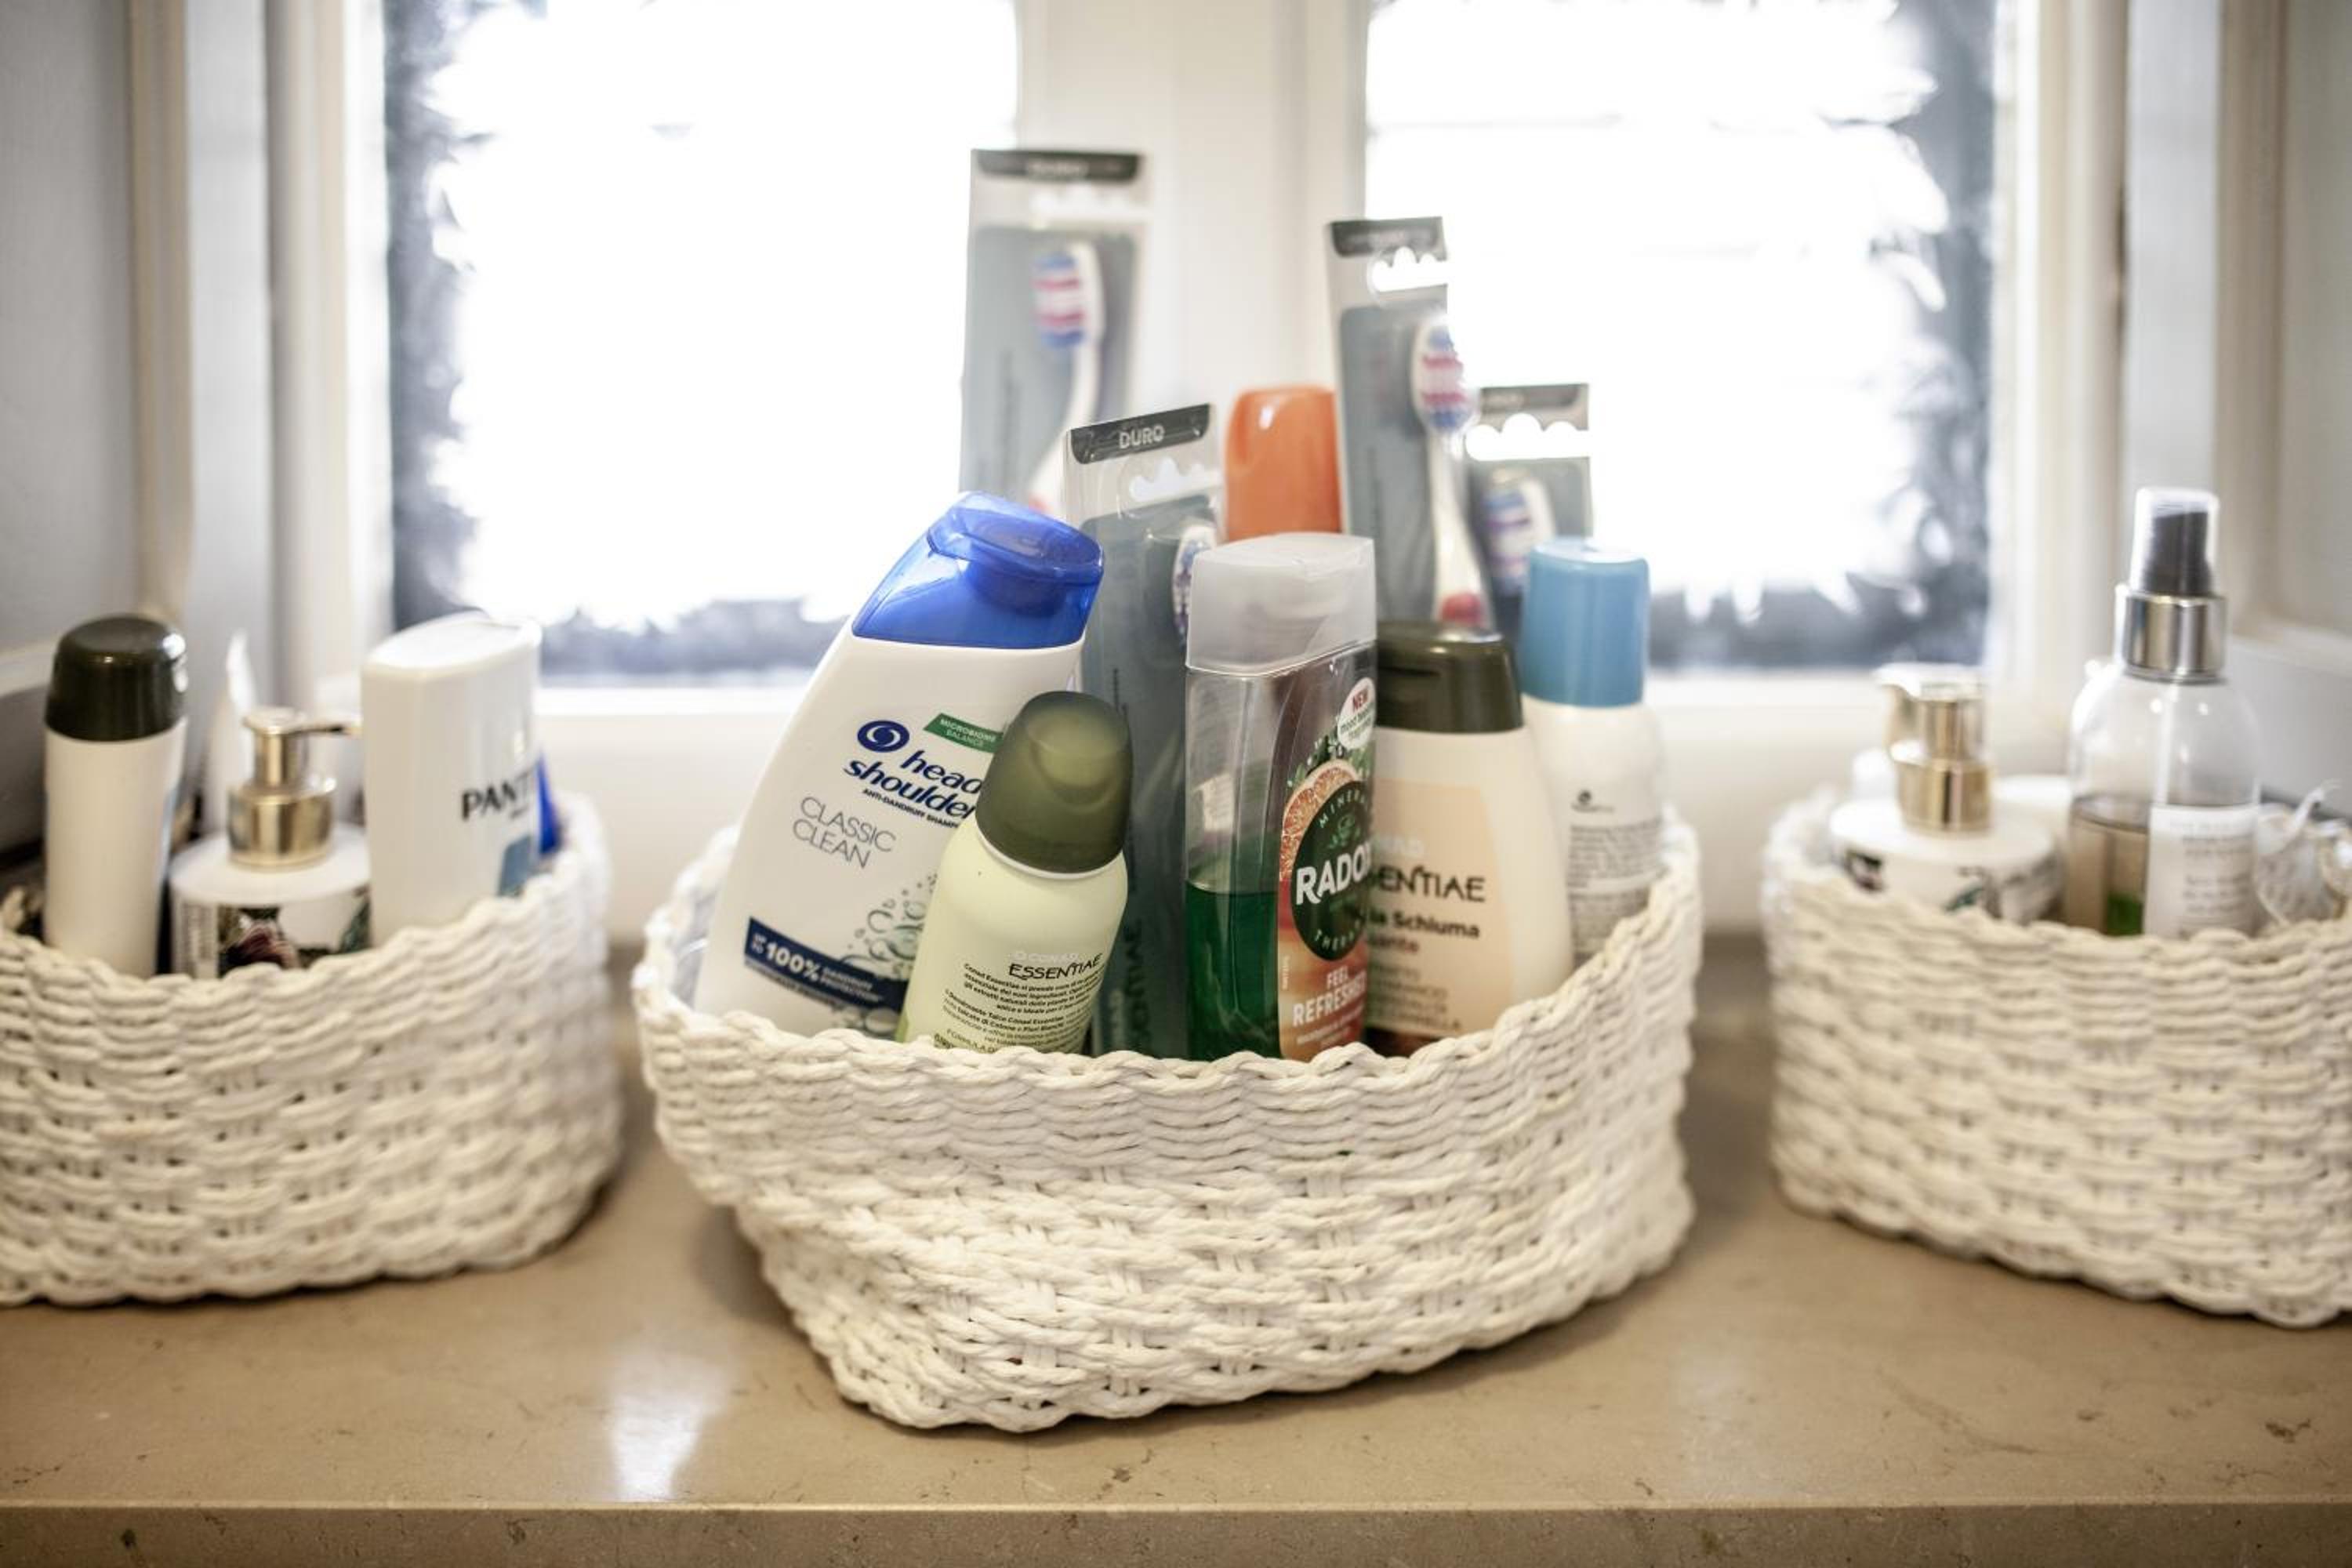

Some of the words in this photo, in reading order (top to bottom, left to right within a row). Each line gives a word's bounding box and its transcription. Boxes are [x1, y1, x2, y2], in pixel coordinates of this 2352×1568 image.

[1119, 423, 1165, 449] DURO
[462, 771, 532, 821] PANT
[844, 759, 976, 820] shoulder
[862, 788, 926, 818] ANTI-DANDRUFF
[793, 818, 871, 869] CLEAN
[800, 796, 897, 853] CLASSIC
[1377, 864, 1486, 902] ENTIAE
[765, 942, 822, 982] 100%
[1008, 953, 1103, 981] ESSENTIAE
[1327, 965, 1348, 989] FEEL
